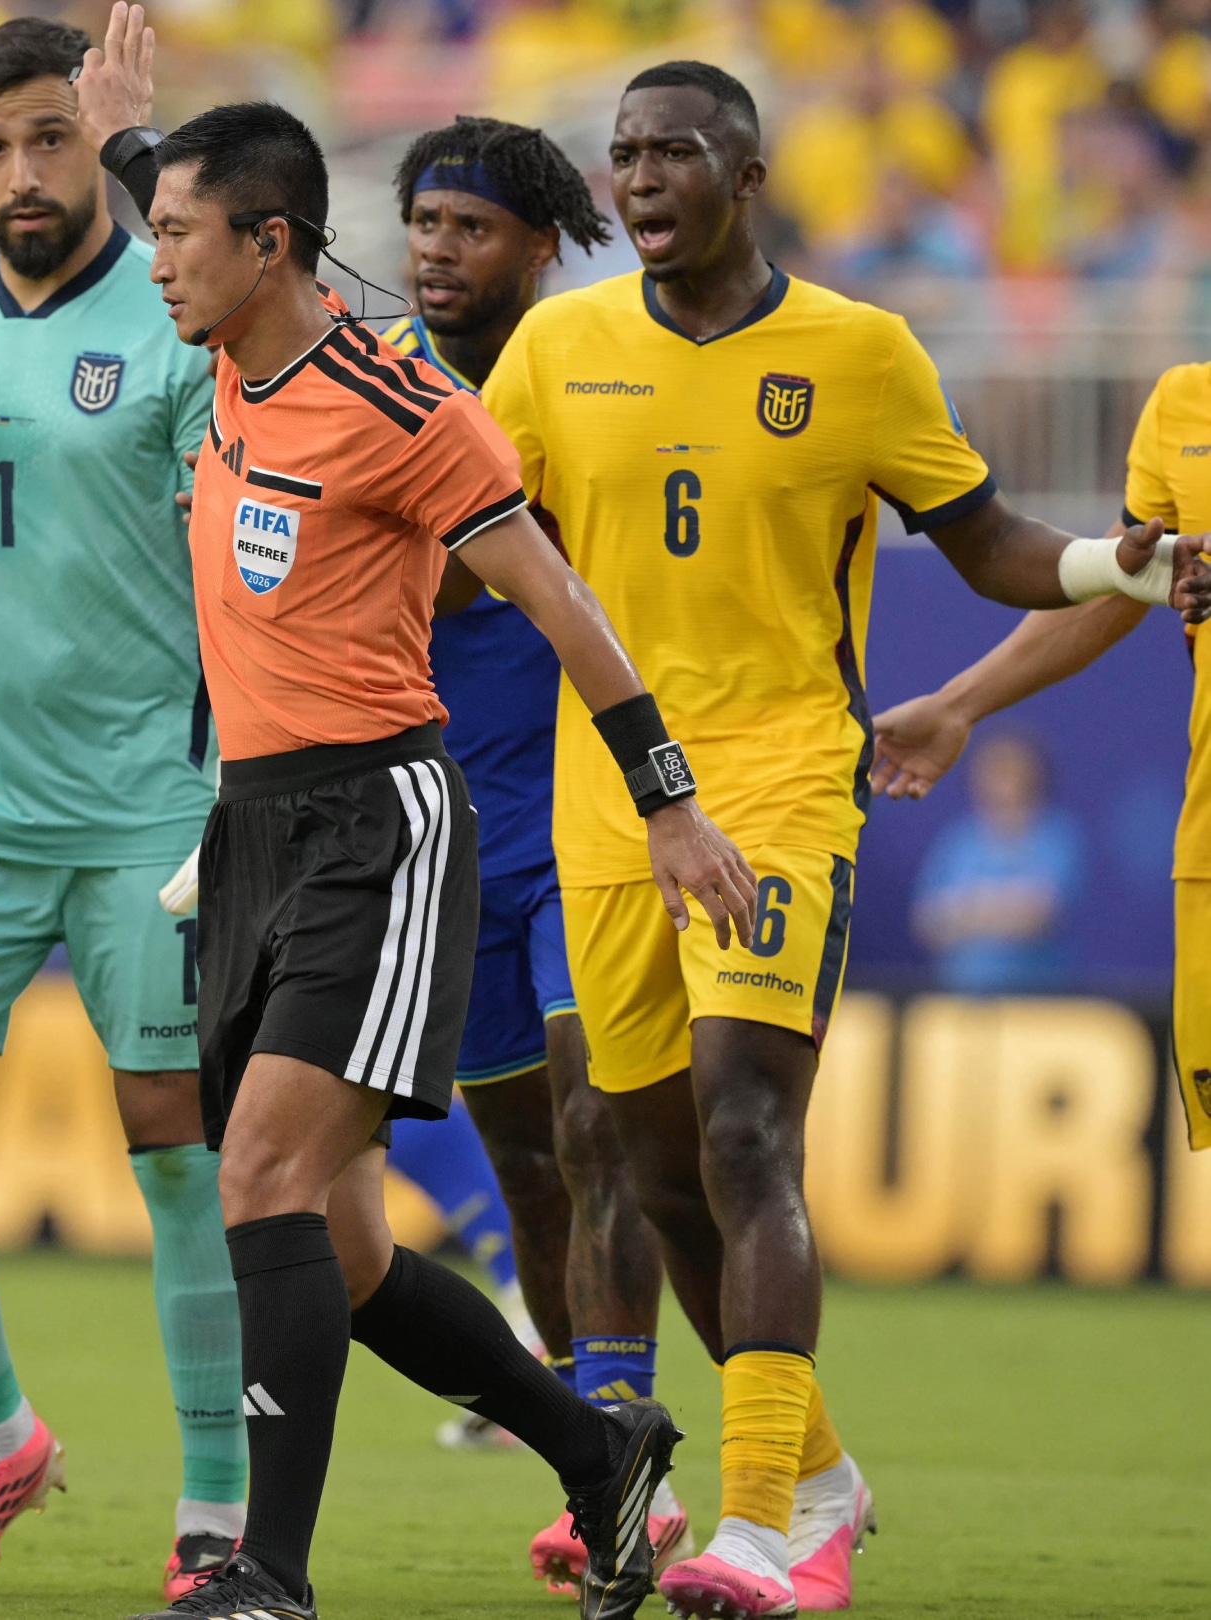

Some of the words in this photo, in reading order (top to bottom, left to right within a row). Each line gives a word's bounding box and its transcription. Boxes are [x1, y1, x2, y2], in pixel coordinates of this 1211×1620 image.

[565, 381, 654, 396] marathon
[239, 504, 291, 537] FIFA
[664, 469, 702, 558] 6
[238, 539, 288, 563] REFEREE
[247, 572, 270, 588] 2026
[663, 752, 689, 791] 49:04
[749, 875, 792, 958] 6
[175, 918, 197, 1005] 1
[717, 970, 804, 997] marathon
[140, 1020, 198, 1039] marat
